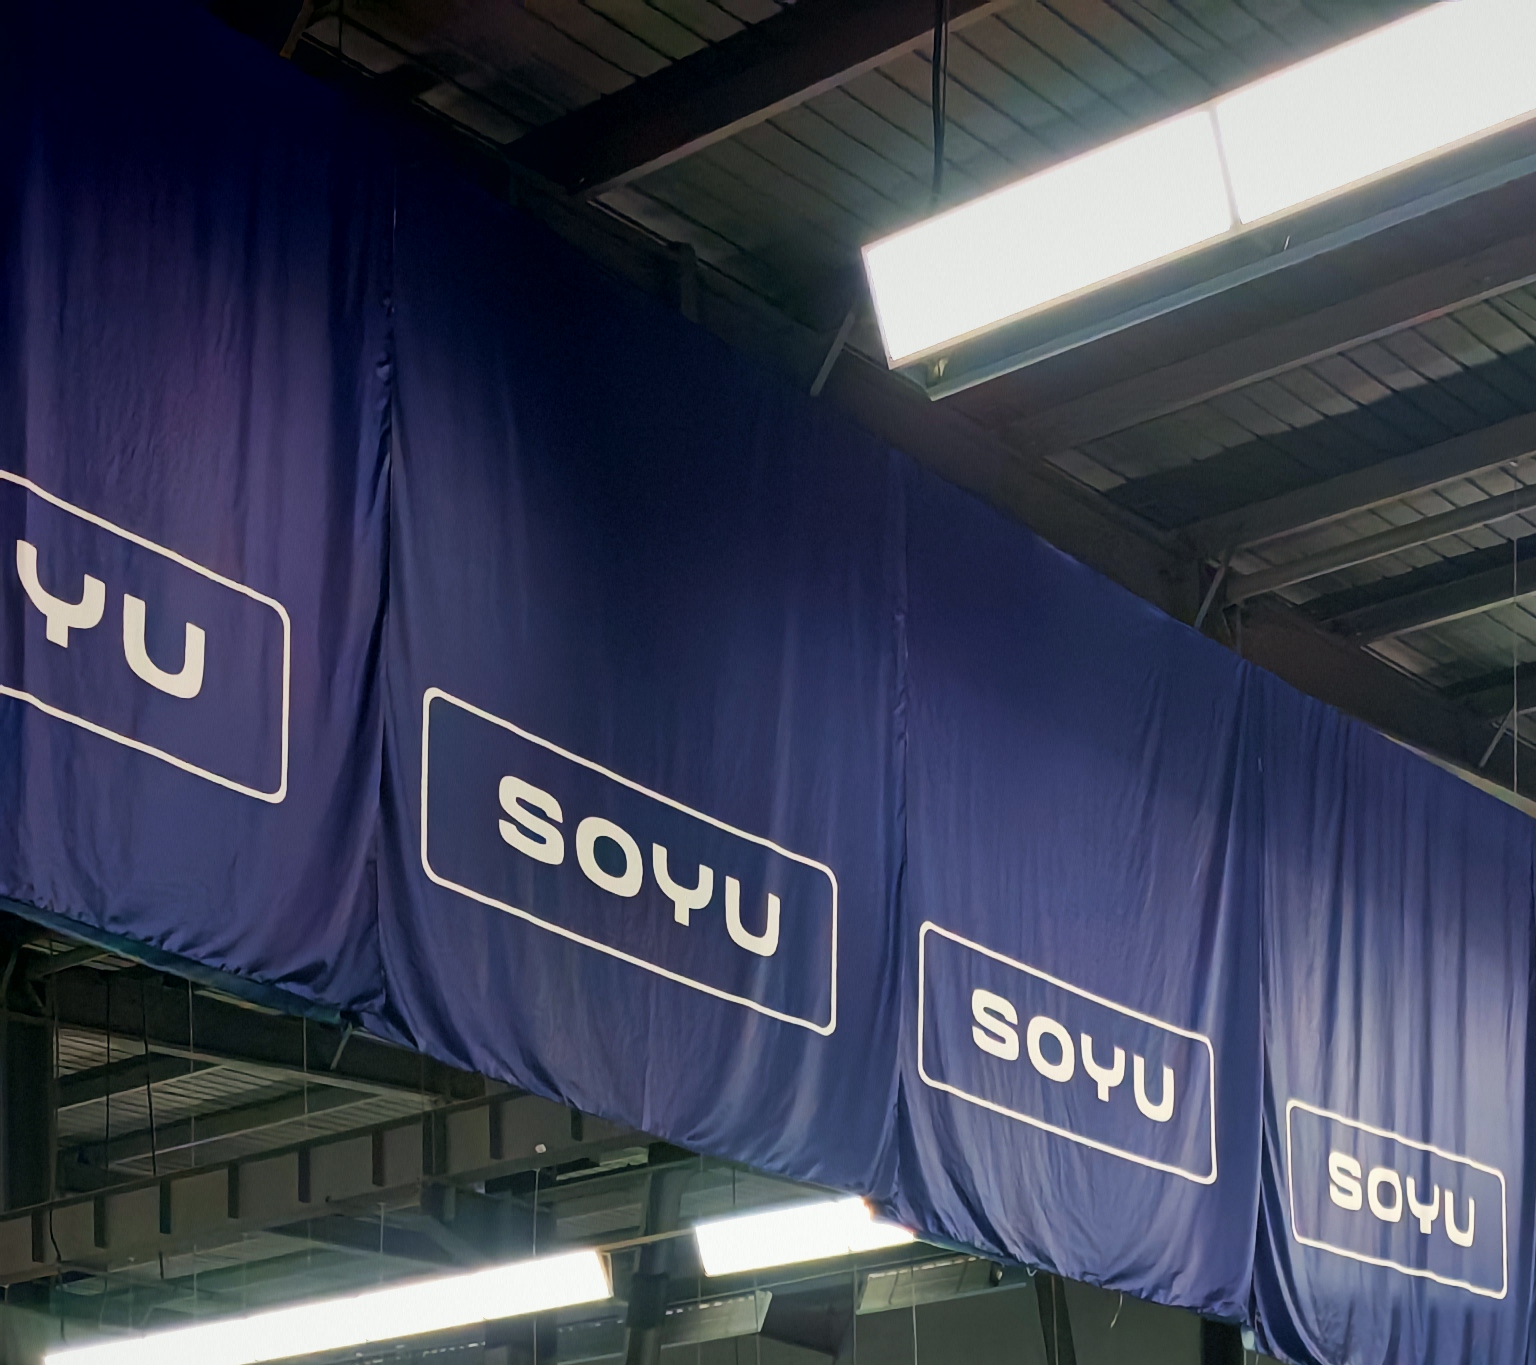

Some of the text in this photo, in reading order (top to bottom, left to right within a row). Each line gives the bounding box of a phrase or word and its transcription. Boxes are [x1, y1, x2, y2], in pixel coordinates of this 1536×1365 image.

[498, 776, 780, 957] SOYU
[971, 989, 1175, 1123] SOYU
[1328, 1153, 1475, 1248] SOYU
